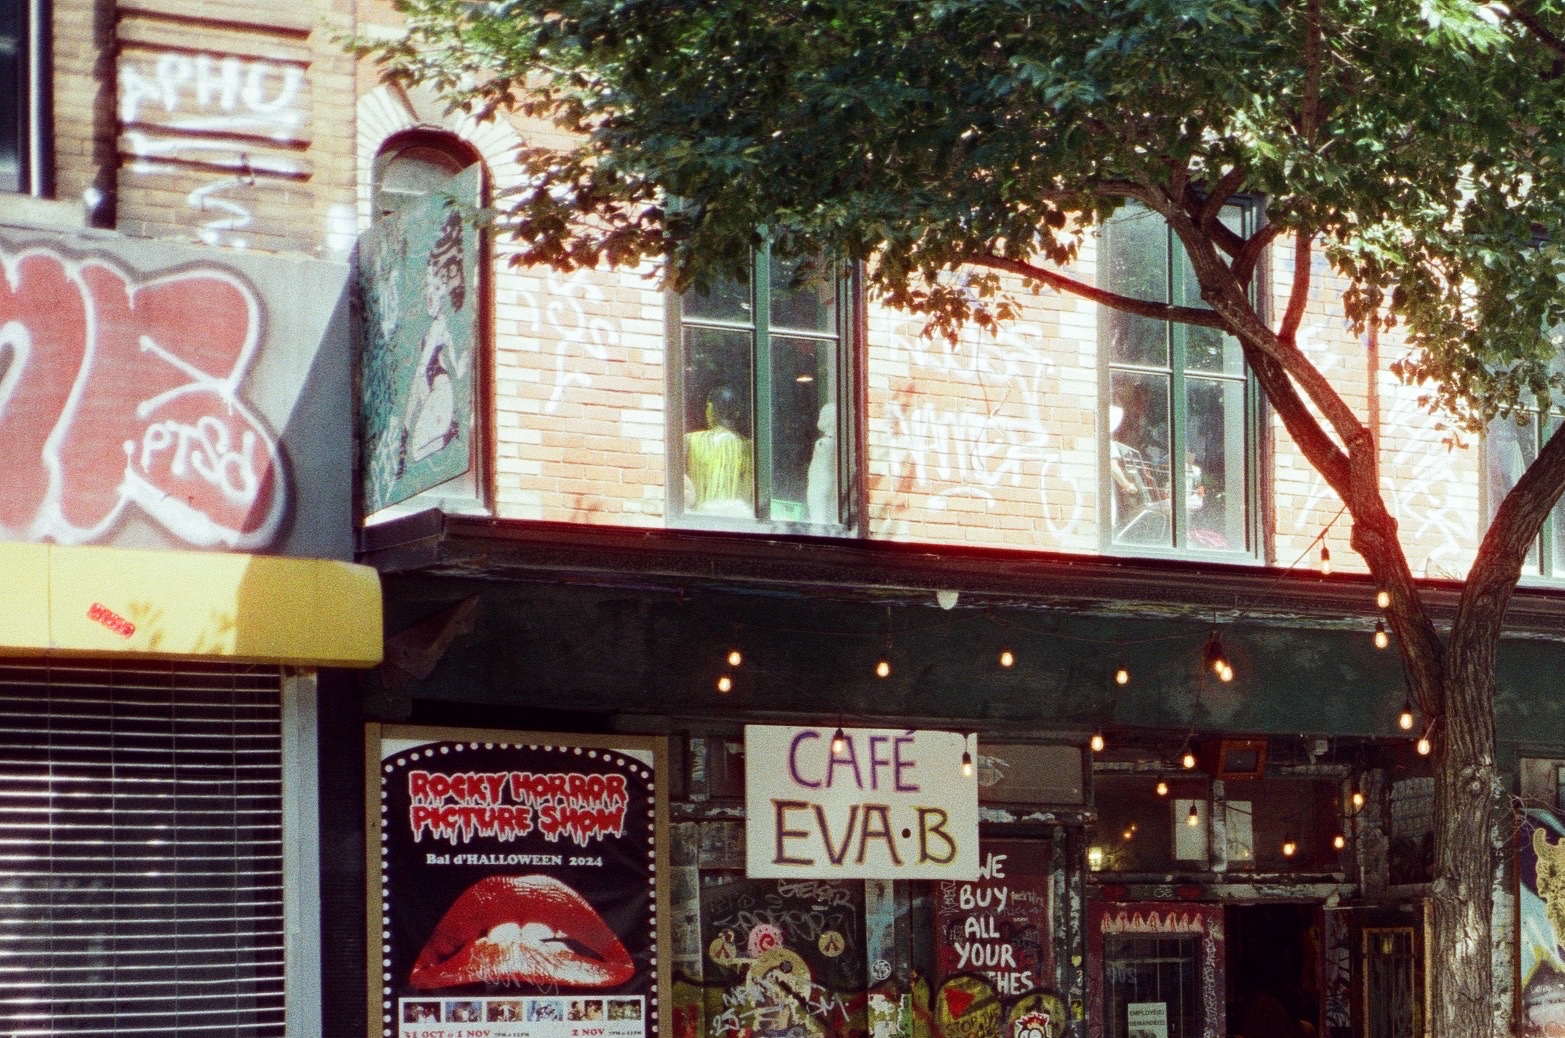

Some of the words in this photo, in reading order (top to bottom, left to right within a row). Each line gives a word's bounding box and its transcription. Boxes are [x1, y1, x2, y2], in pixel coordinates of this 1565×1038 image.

[788, 729, 920, 792] CAFÉ
[409, 770, 508, 806] ROCKY
[510, 771, 629, 810] HORROR
[410, 804, 533, 845] PICTURE
[538, 804, 628, 847] SHOW
[426, 853, 450, 865] Bal
[569, 857, 603, 867] 2024
[959, 884, 1008, 914] BUY
[964, 916, 1000, 939] ALL
[954, 942, 1017, 969] YOUR
[421, 1030, 445, 1038] OCT
[467, 1029, 490, 1038] NOV
[582, 1028, 605, 1036] NOV
